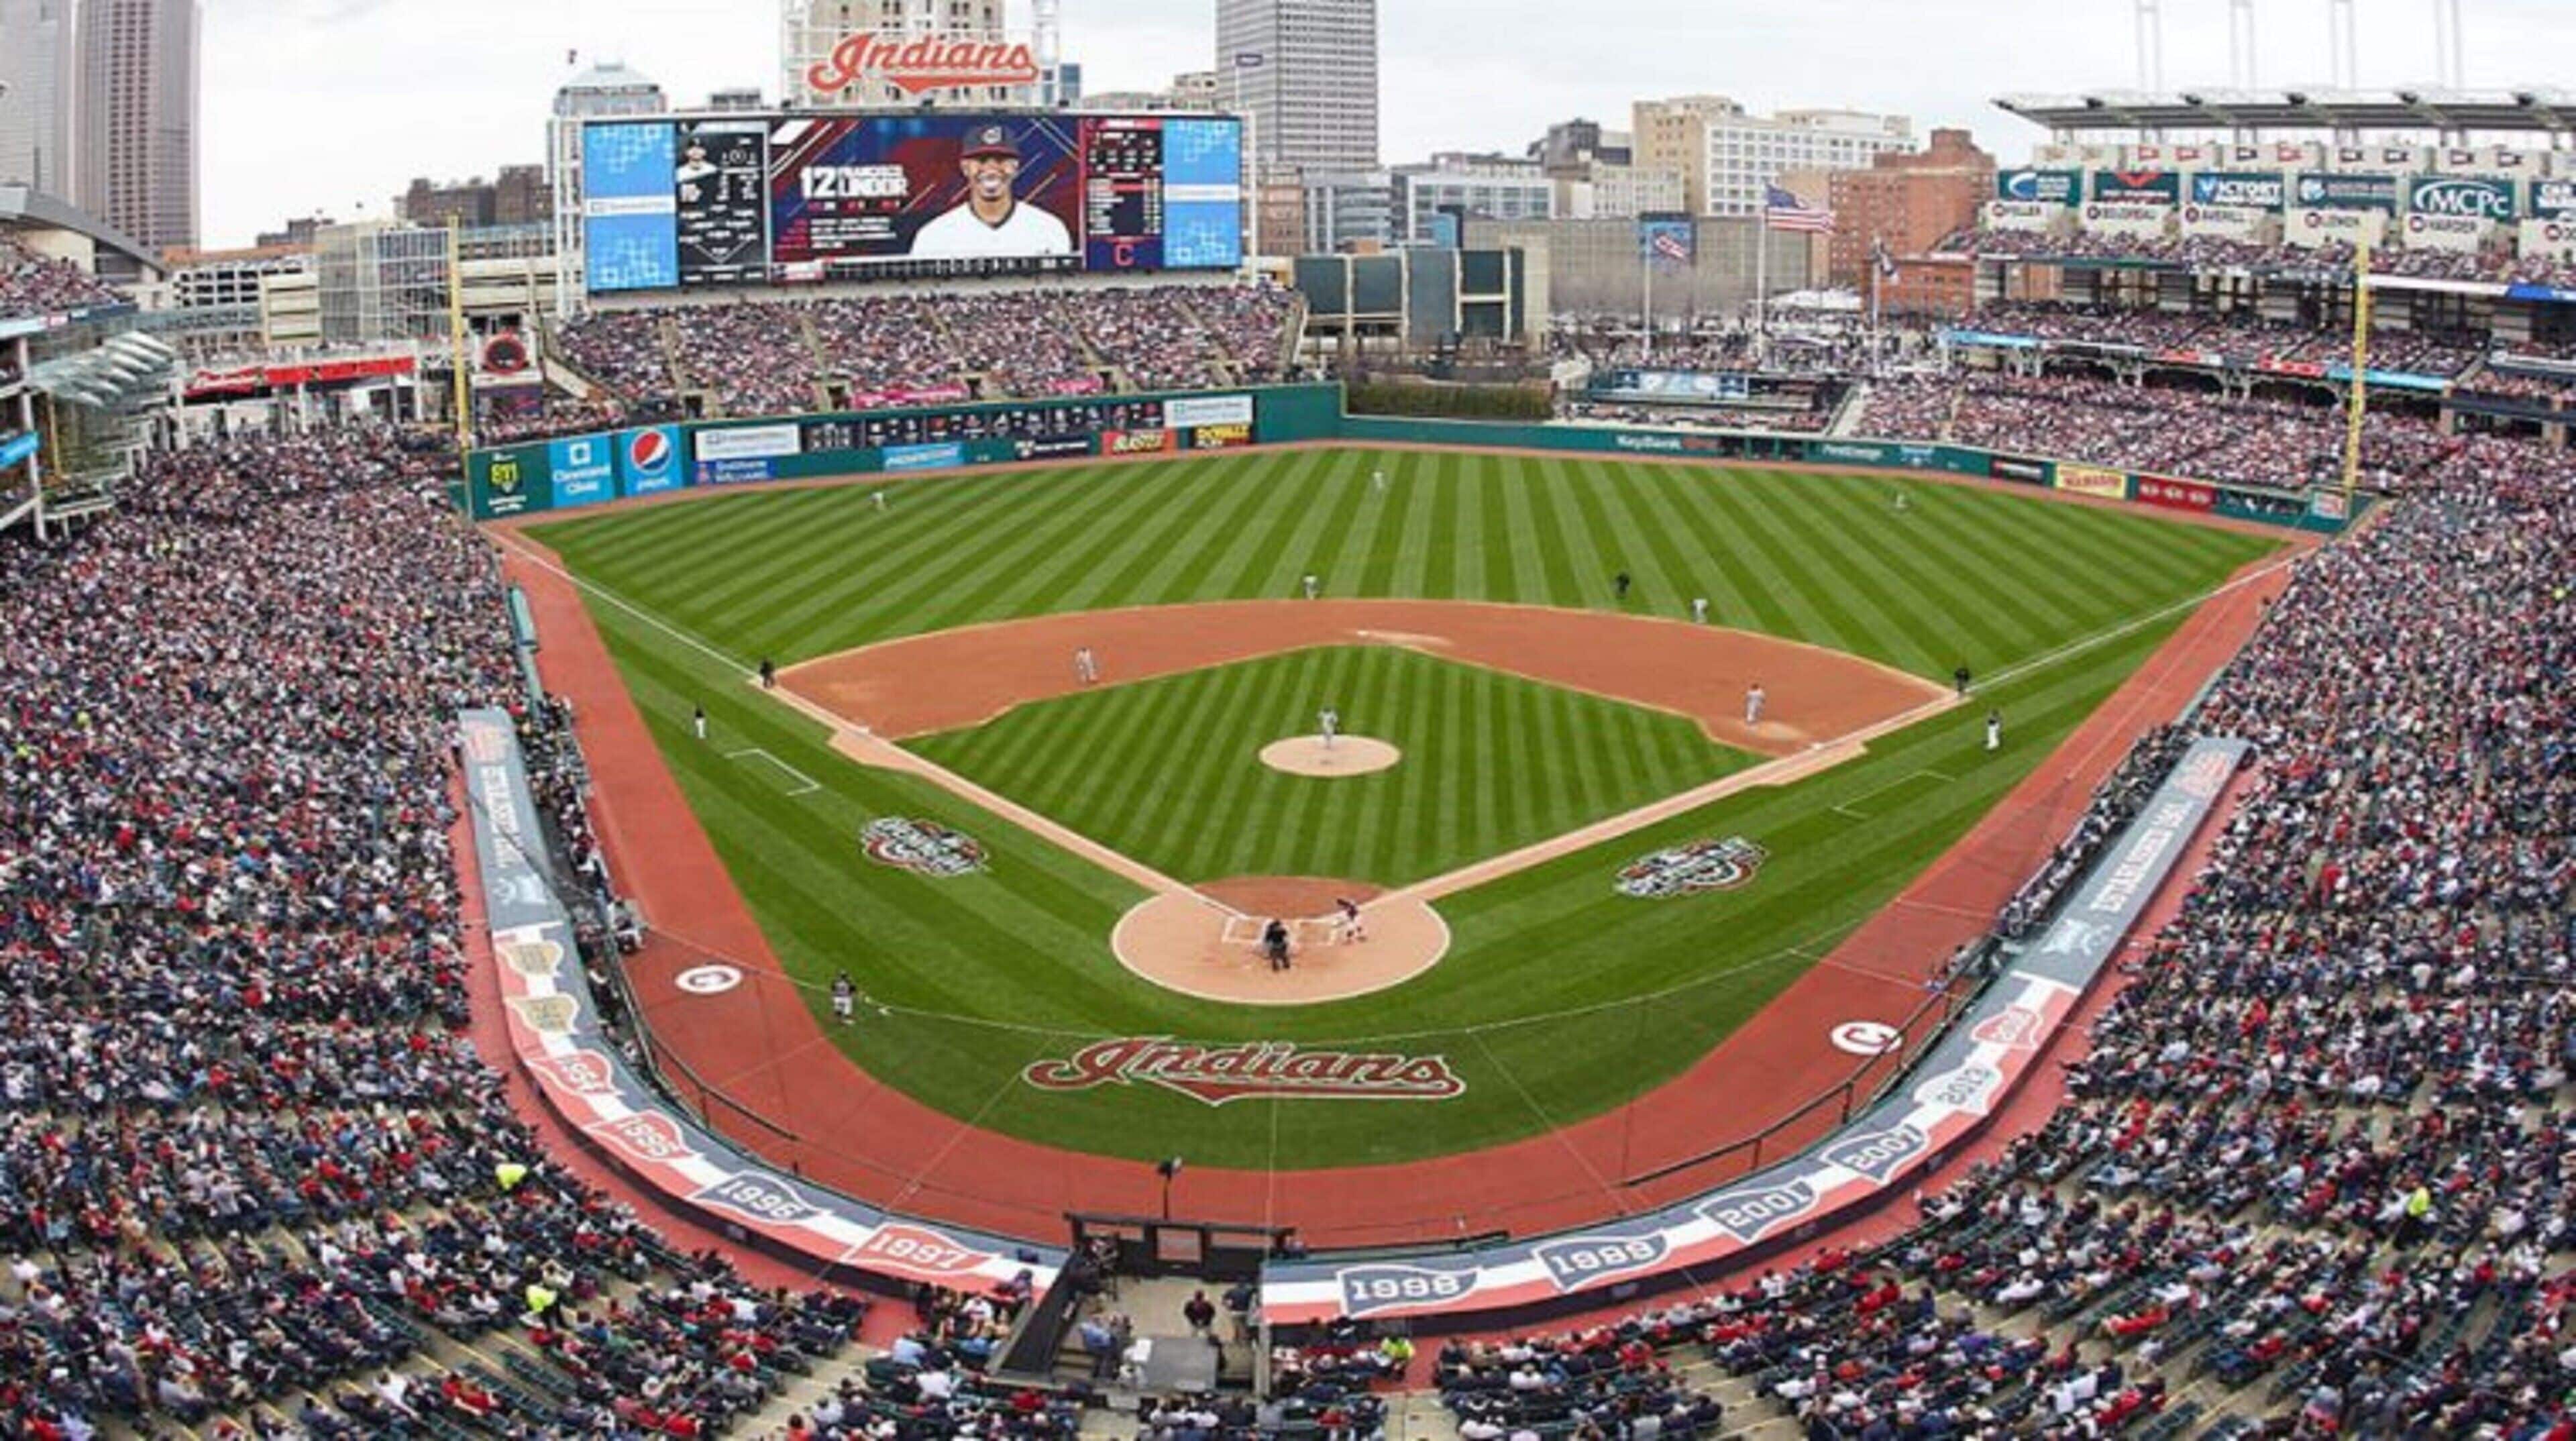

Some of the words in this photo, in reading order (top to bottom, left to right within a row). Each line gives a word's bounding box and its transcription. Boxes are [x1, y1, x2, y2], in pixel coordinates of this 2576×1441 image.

[807, 33, 1040, 93] Indians
[800, 166, 837, 198] 12
[2429, 188, 2510, 215] MCPc
[1113, 243, 1134, 266] C
[1022, 1035, 1468, 1107] Indians
[1716, 1187, 1811, 1228] 2001
[868, 1233, 969, 1269] 1997
